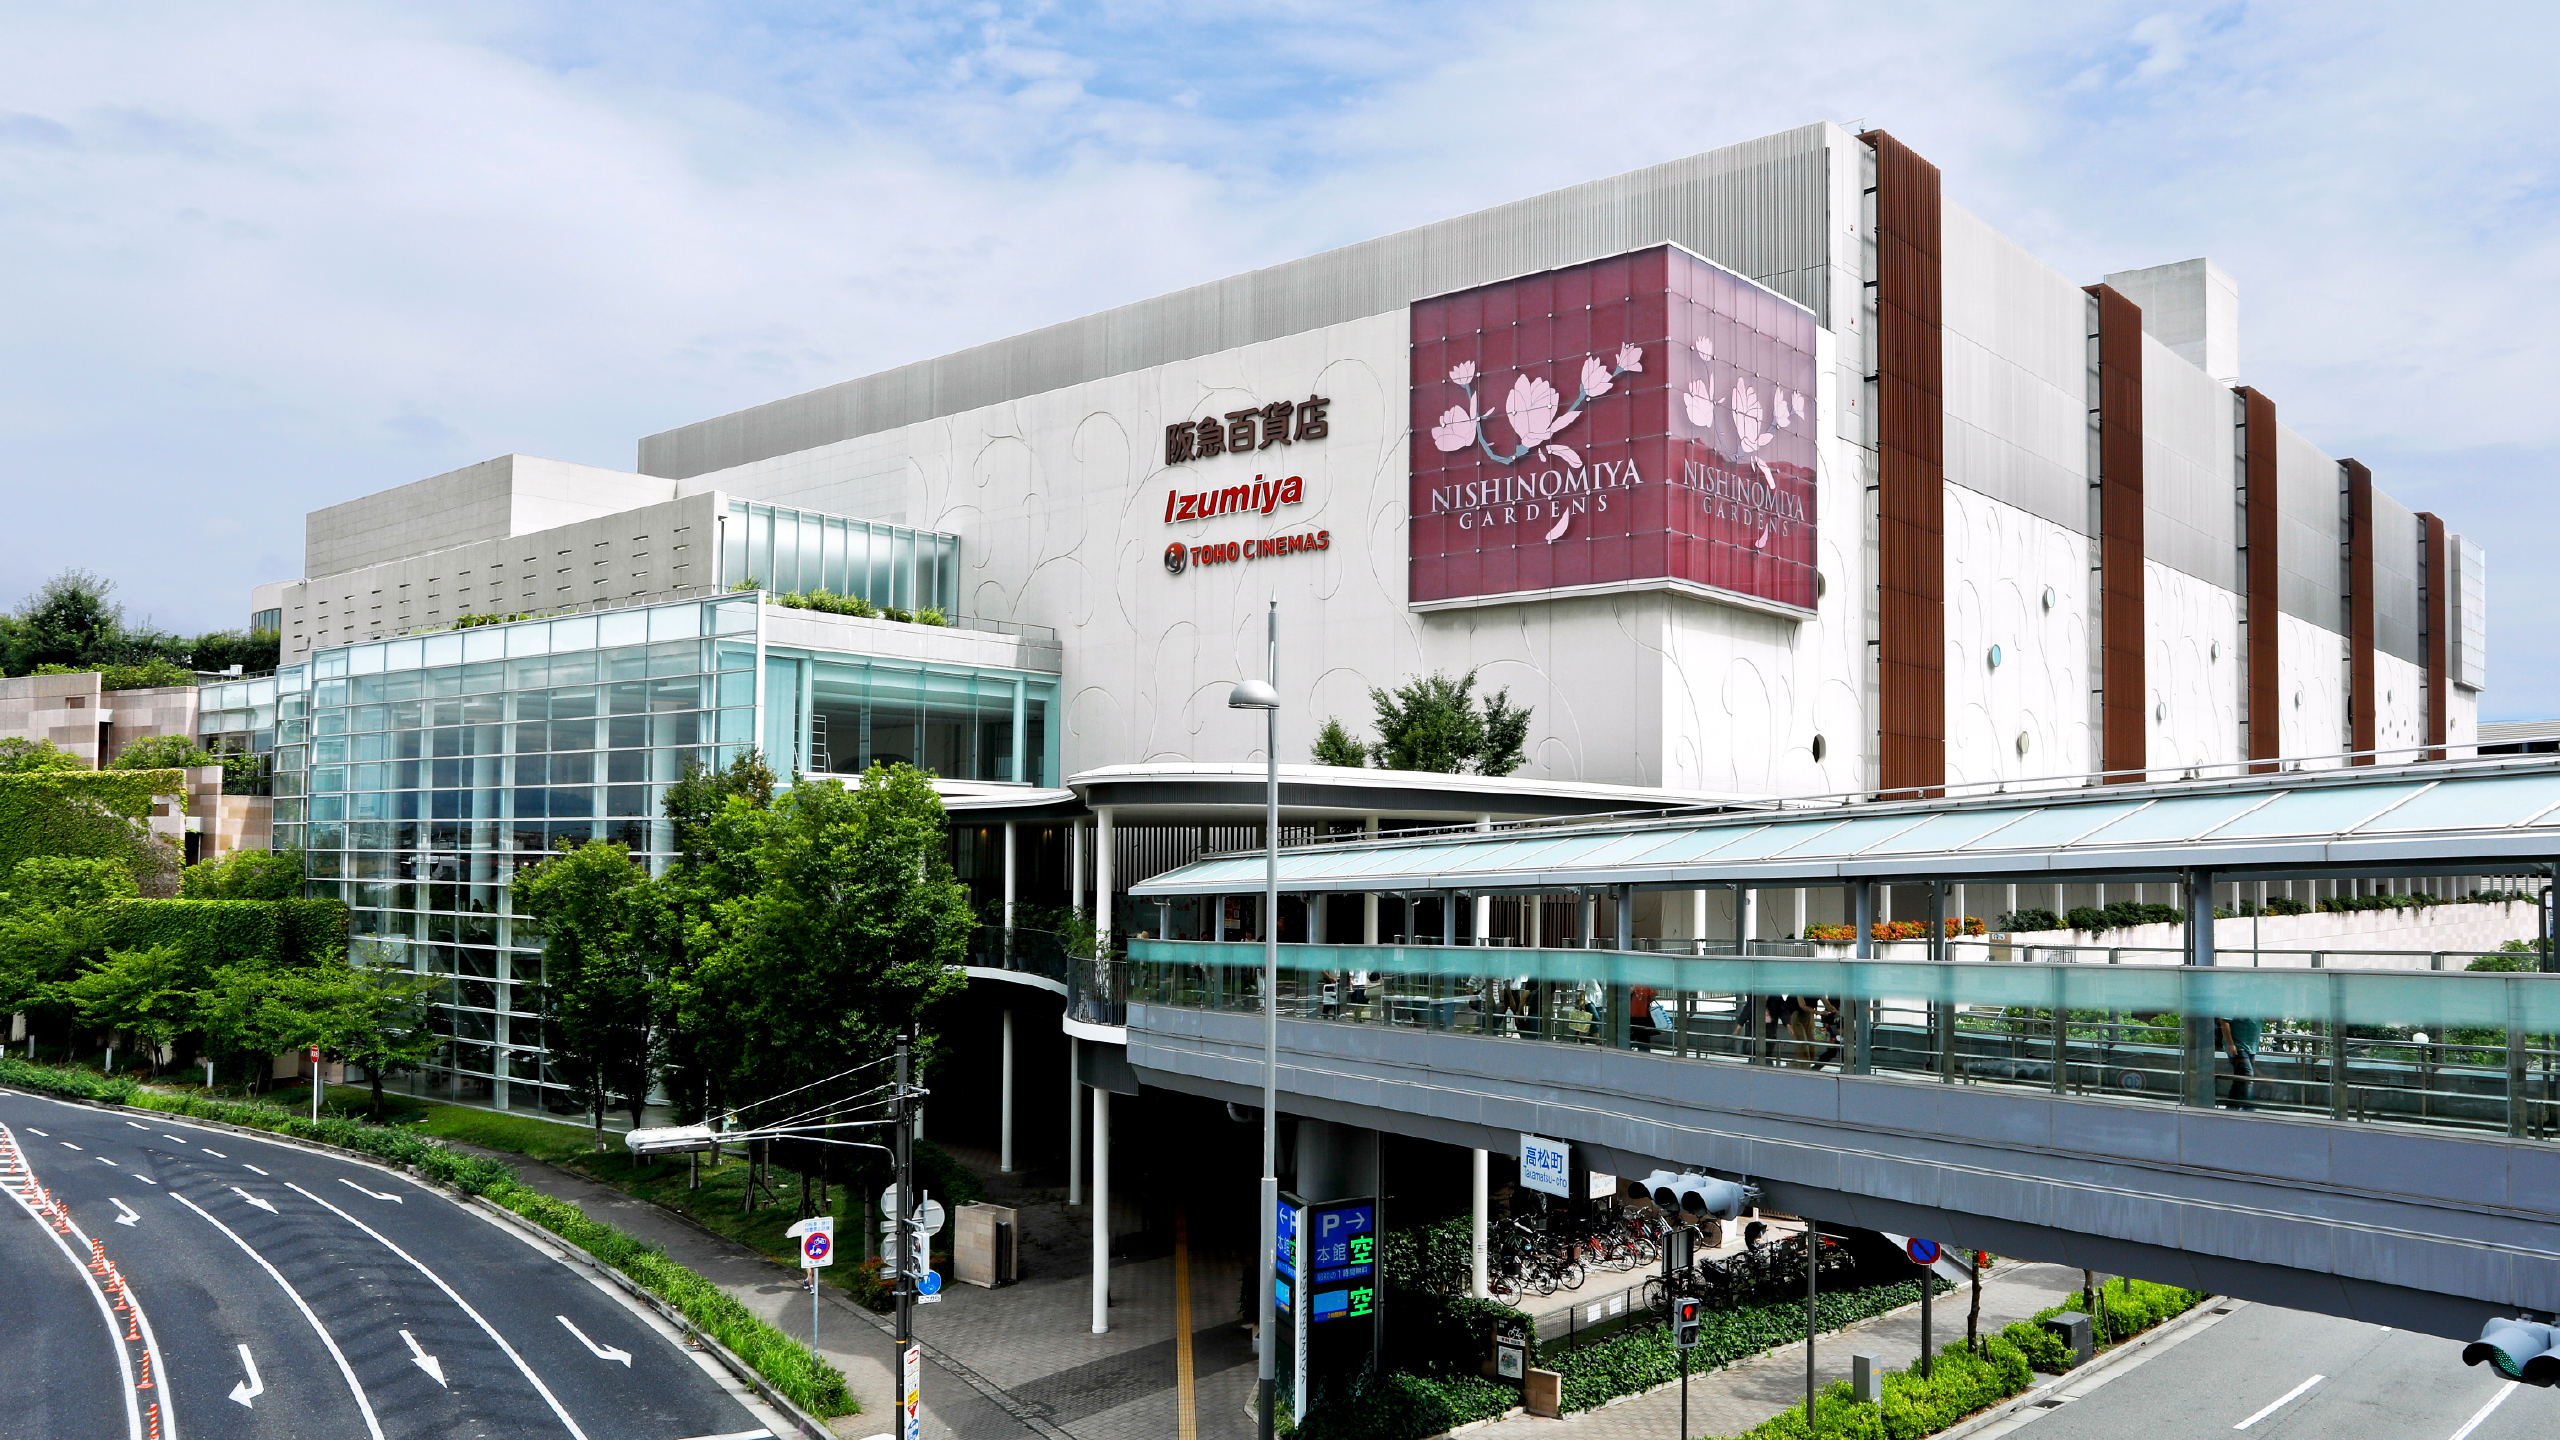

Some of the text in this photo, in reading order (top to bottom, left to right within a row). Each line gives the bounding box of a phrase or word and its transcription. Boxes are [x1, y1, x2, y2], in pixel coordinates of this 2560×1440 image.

[1165, 394, 1331, 466] 阪急百貨店
[1163, 473, 1305, 525] Izumiya
[1431, 458, 1644, 513] NISHINOMIYA
[1683, 458, 1806, 522] NISHINOMIYA
[1459, 494, 1607, 530] GARDENS
[1703, 496, 1789, 537] GARDENS
[1190, 530, 1330, 567] TOHO CINEMAS
[1523, 1165, 1567, 1188] Takamatsu-cho
[1526, 1146, 1563, 1174] 高松町
[1322, 1214, 1340, 1238] P
[1317, 1243, 1346, 1264] 本館
[1350, 1235, 1374, 1265] 空
[1350, 1286, 1373, 1317] 空
